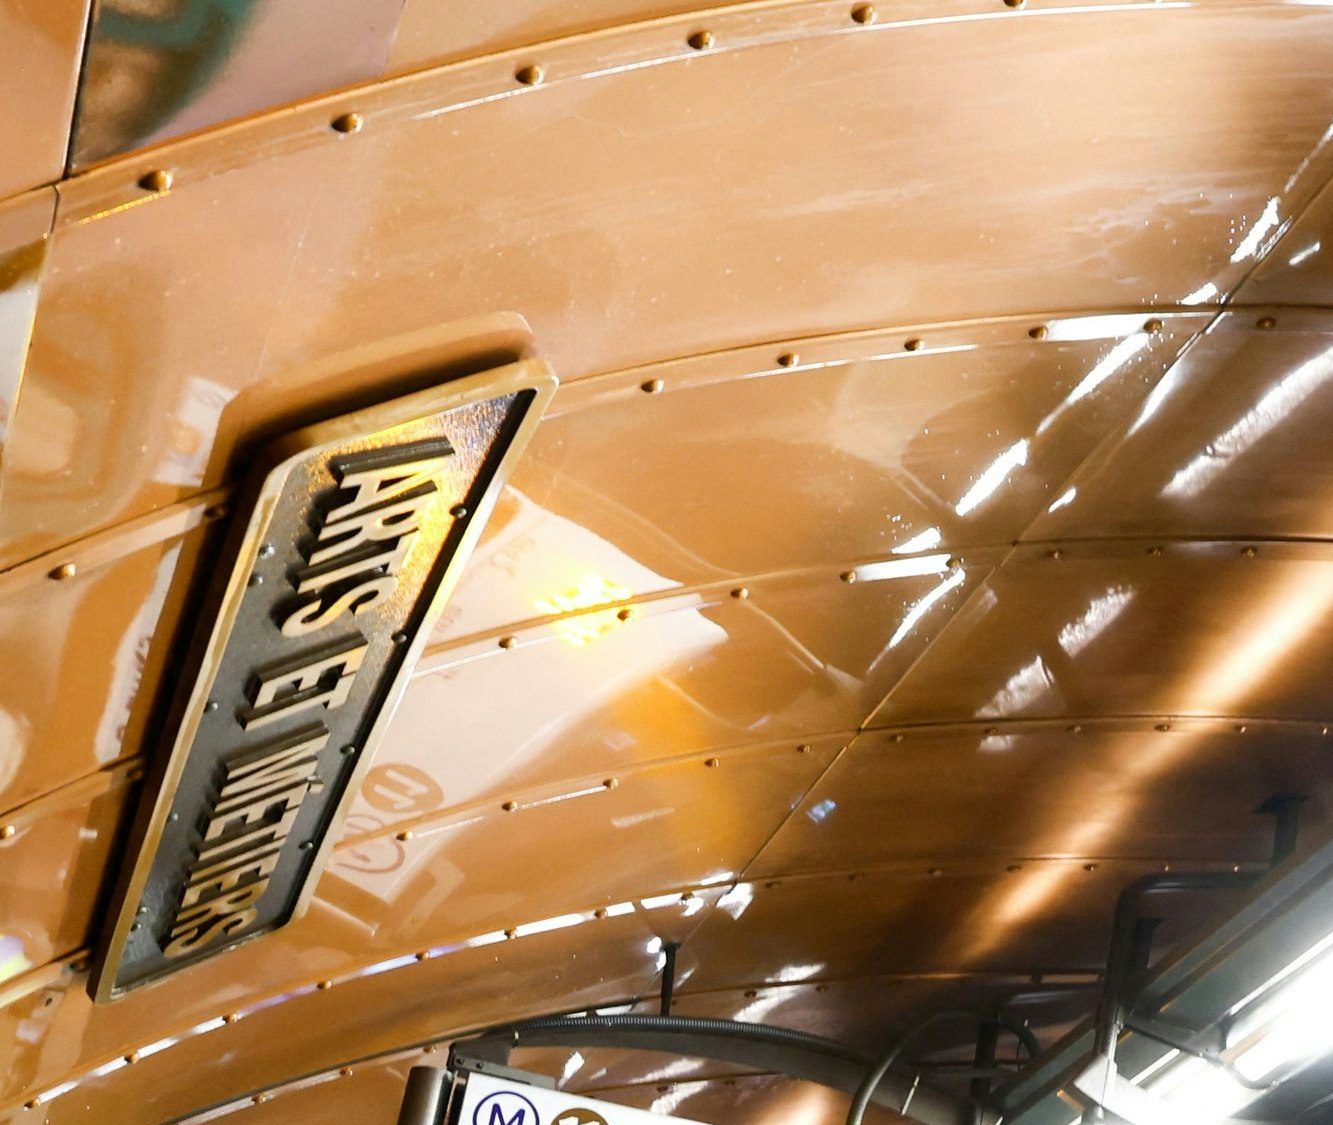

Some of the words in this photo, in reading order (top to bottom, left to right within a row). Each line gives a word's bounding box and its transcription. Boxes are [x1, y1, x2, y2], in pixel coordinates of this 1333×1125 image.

[281, 440, 454, 638] ARTS
[240, 636, 369, 732] ET
[163, 724, 330, 957] MÉTIERS
